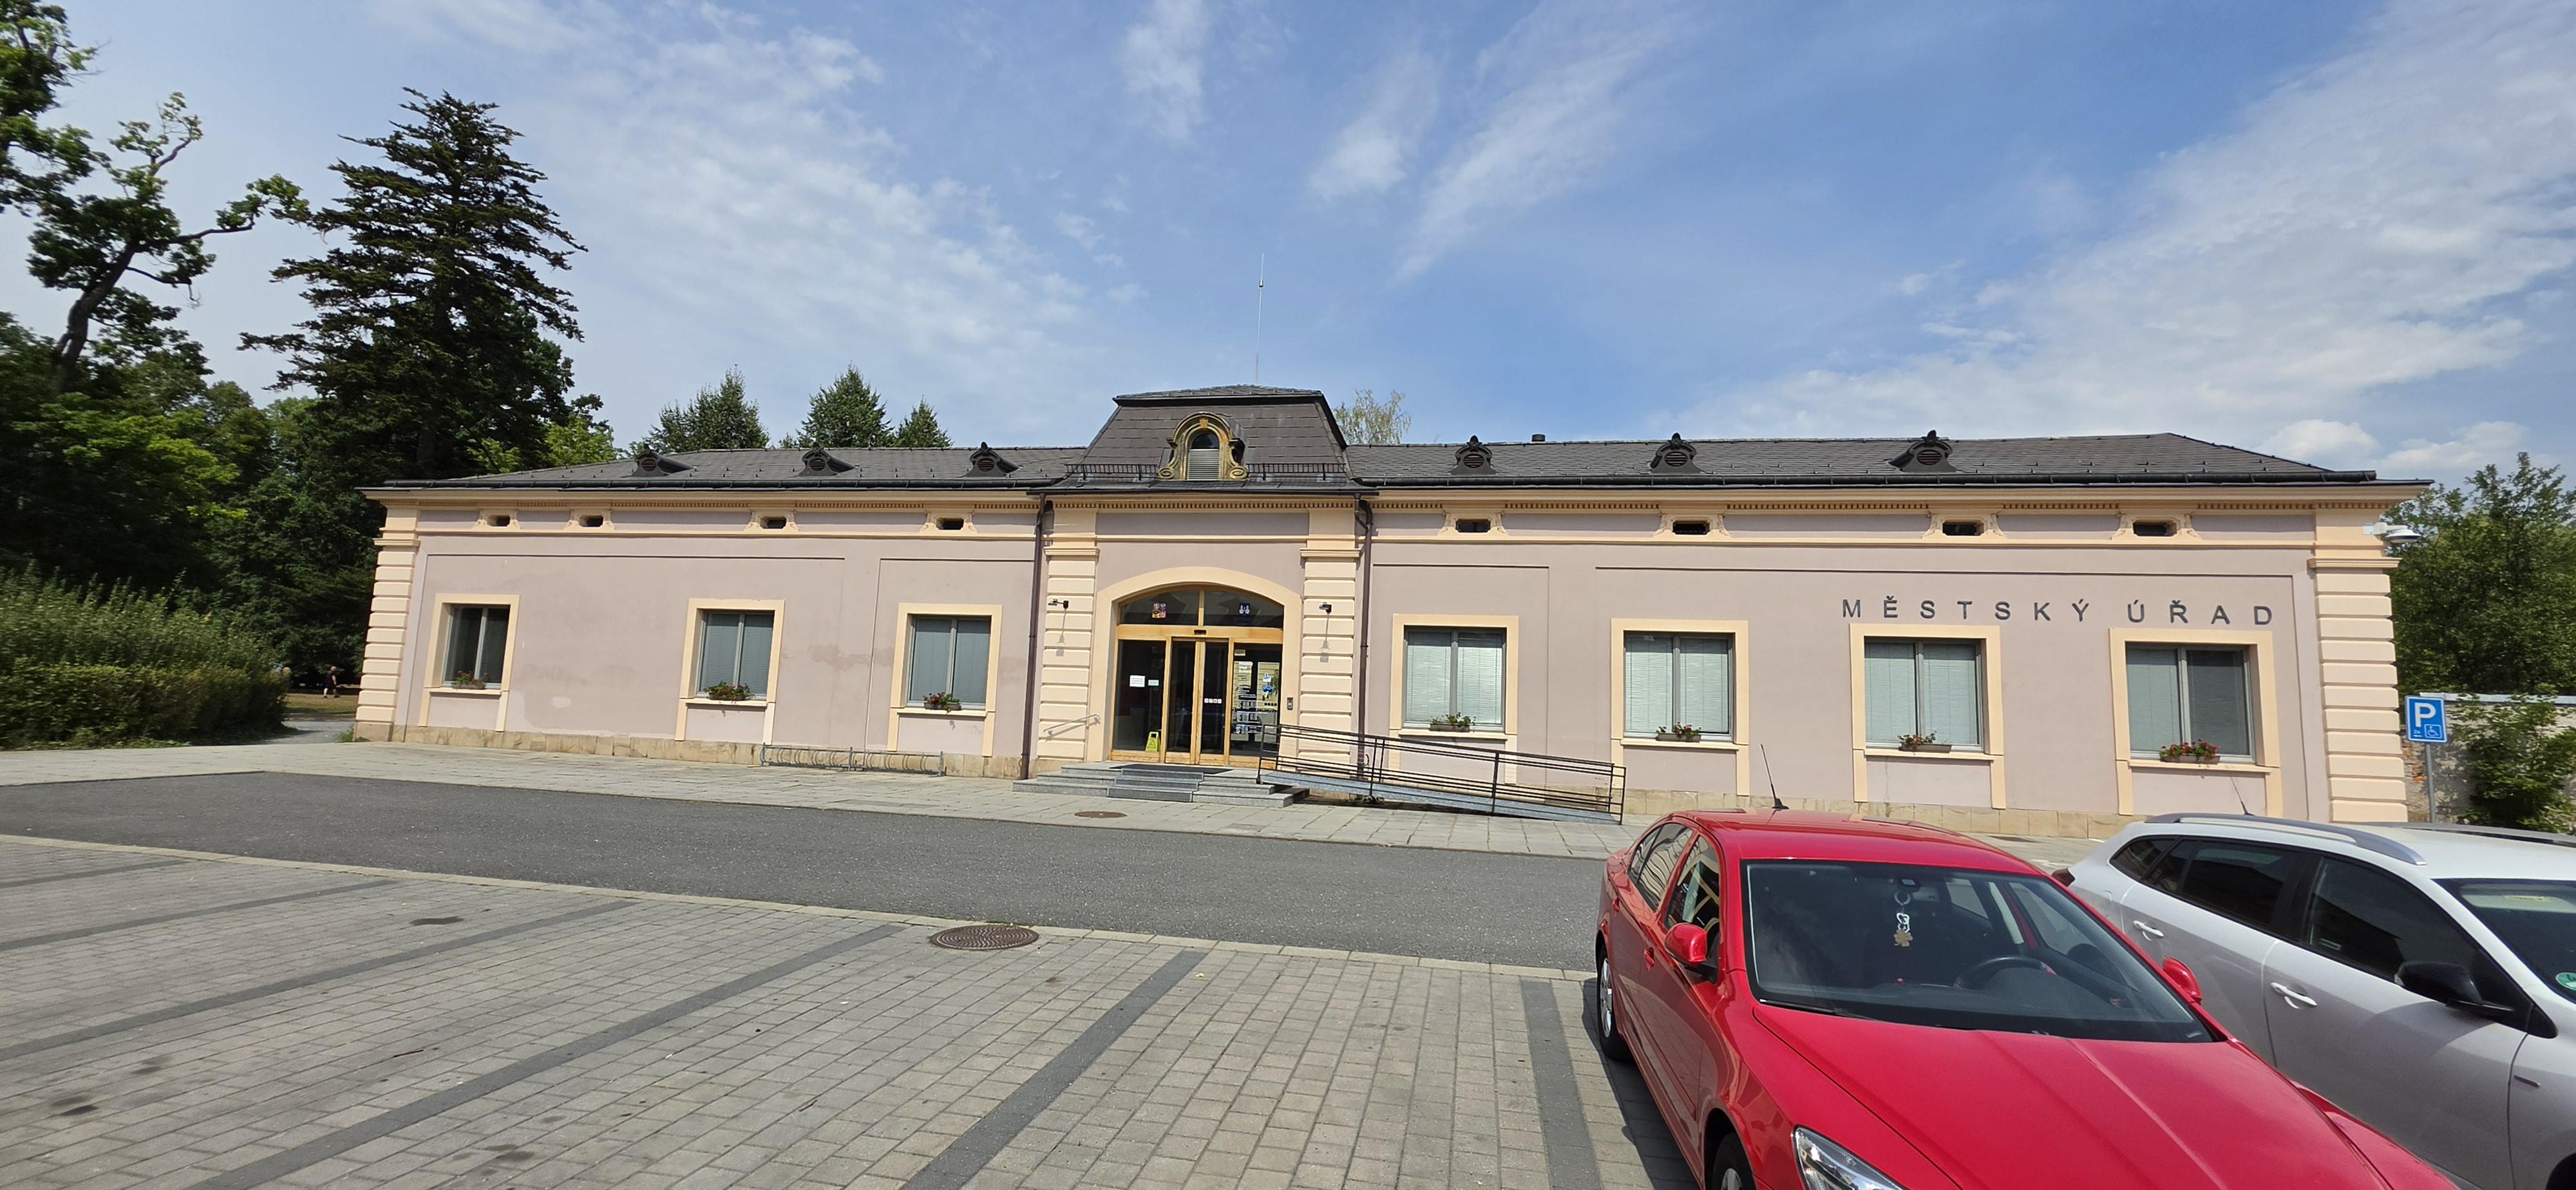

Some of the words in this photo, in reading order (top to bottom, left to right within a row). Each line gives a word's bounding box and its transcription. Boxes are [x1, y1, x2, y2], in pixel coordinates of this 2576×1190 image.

[1842, 595, 2090, 621] MĚSTSKÝ
[2127, 599, 2273, 625] ÚŘAD
[2414, 703, 2436, 727] P
